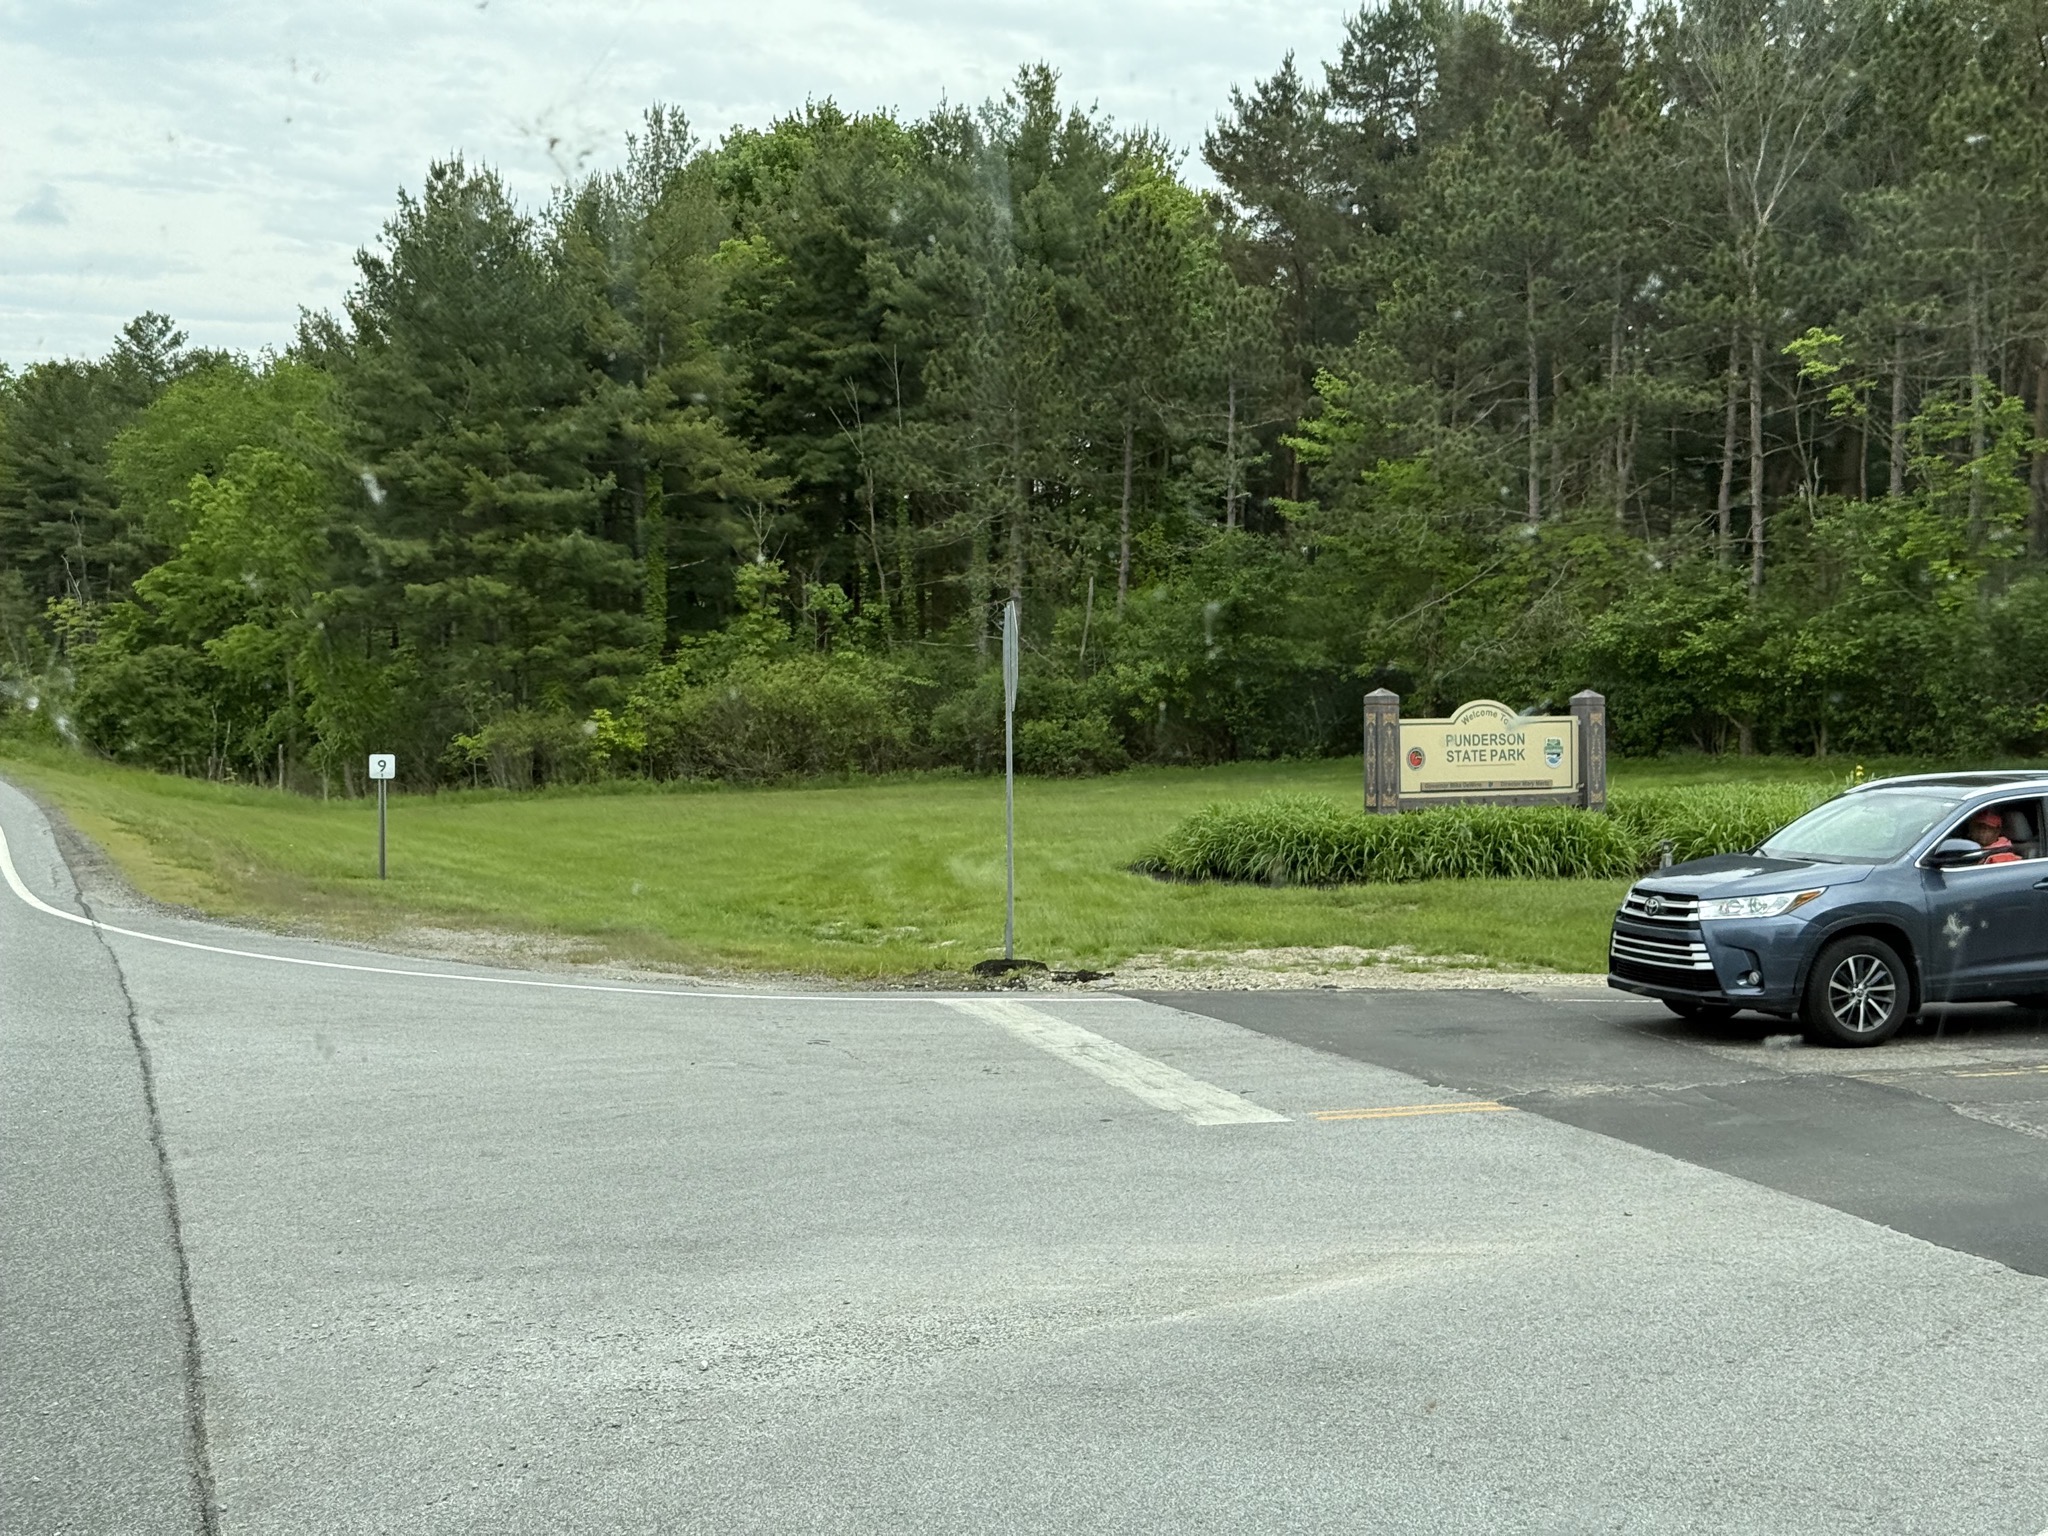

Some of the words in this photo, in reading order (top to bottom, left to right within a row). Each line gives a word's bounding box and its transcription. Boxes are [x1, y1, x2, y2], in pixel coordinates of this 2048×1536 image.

[1461, 710, 1498, 725] Welcome
[1500, 713, 1509, 725] To
[1446, 733, 1525, 747] PUNDERSON
[1446, 750, 1487, 763] STATE
[1490, 749, 1526, 762] PARK
[378, 759, 386, 772] 9
